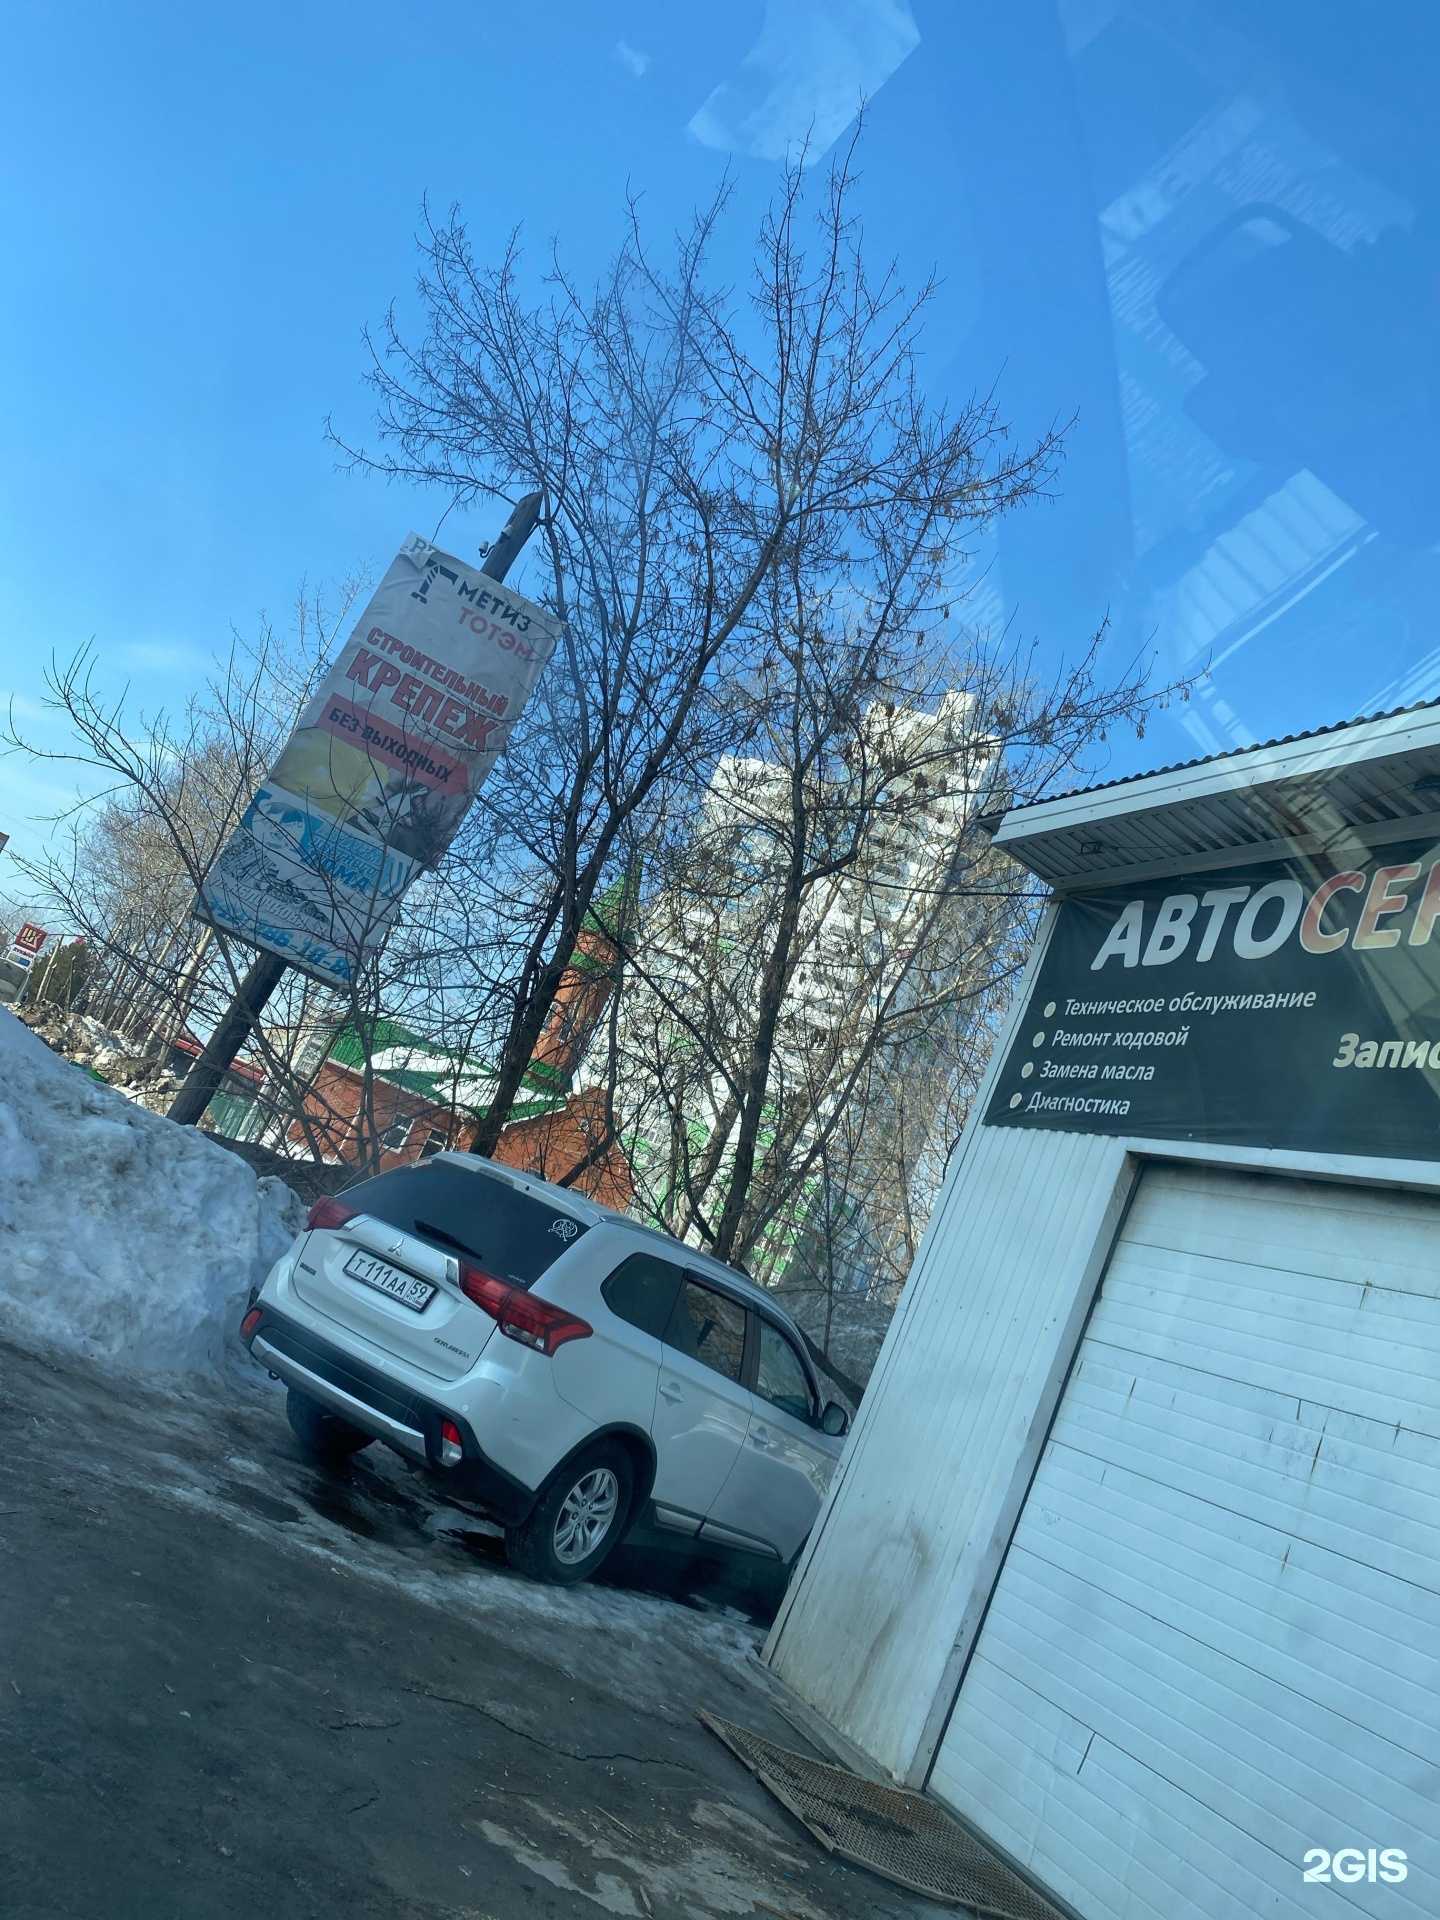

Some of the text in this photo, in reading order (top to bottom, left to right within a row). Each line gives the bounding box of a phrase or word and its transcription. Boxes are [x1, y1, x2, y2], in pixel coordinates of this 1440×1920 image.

[457, 580, 532, 632] МЕТИЗ
[458, 607, 534, 659] ТОТЭМ
[366, 626, 509, 716] СТРОИТЕЛЬНЫЙ
[345, 647, 499, 752] КРЕПЕЖ
[329, 707, 454, 783] БЕЗ ВЫХОДНЫХ
[1063, 988, 1317, 1017] Техническое обслуживание
[1052, 1025, 1189, 1049] Ремонт ходовой
[1039, 1060, 1155, 1081] Замена масла
[1025, 1091, 1130, 1115] Диагностика
[410, 1282, 428, 1298] 59
